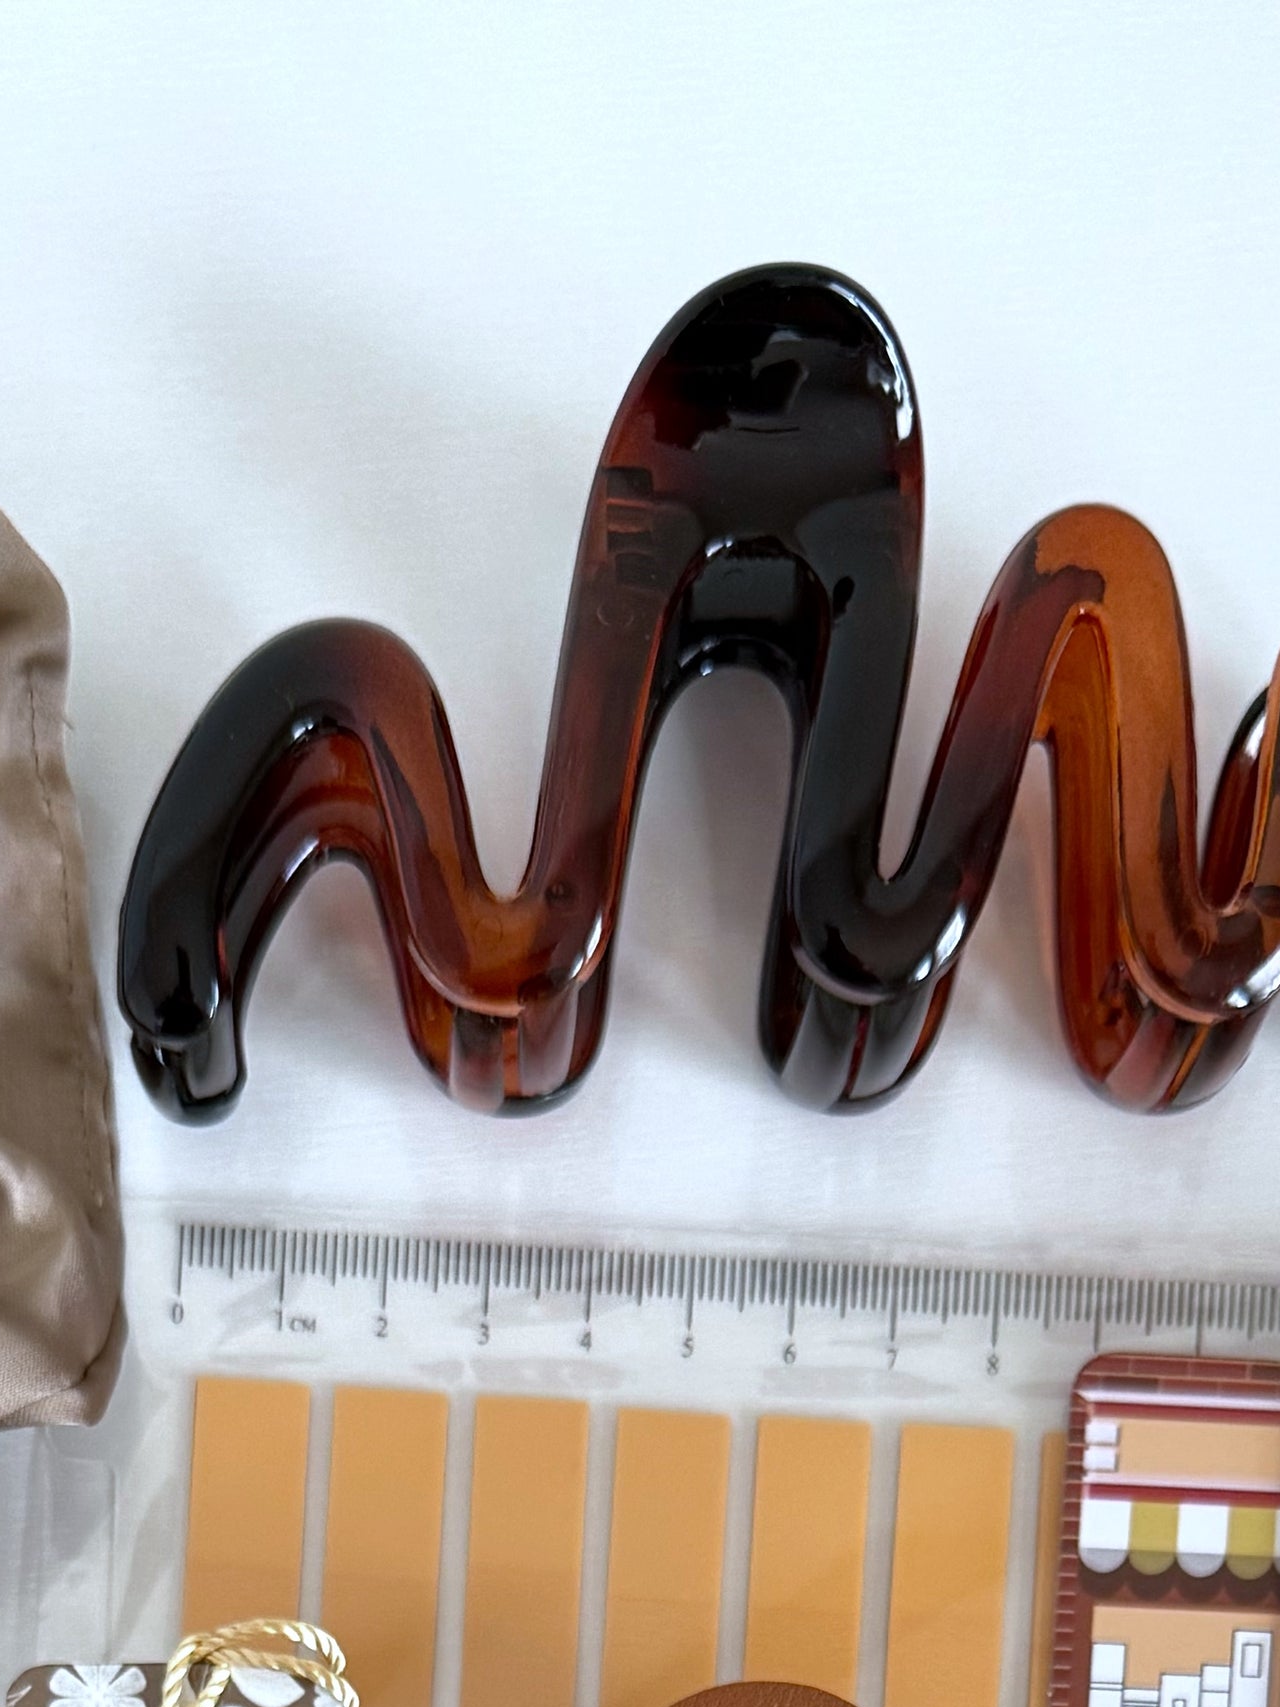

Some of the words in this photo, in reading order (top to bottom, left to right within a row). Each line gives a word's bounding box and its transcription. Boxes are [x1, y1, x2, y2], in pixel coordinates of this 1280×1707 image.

[170, 1303, 185, 1326] 0
[375, 1316, 389, 1339] 2
[476, 1322, 491, 1346] 3
[577, 1329, 593, 1353] 4
[680, 1336, 695, 1360] 5
[782, 1342, 797, 1365] 6
[885, 1348, 899, 1371] 7
[986, 1353, 999, 1377] 8
